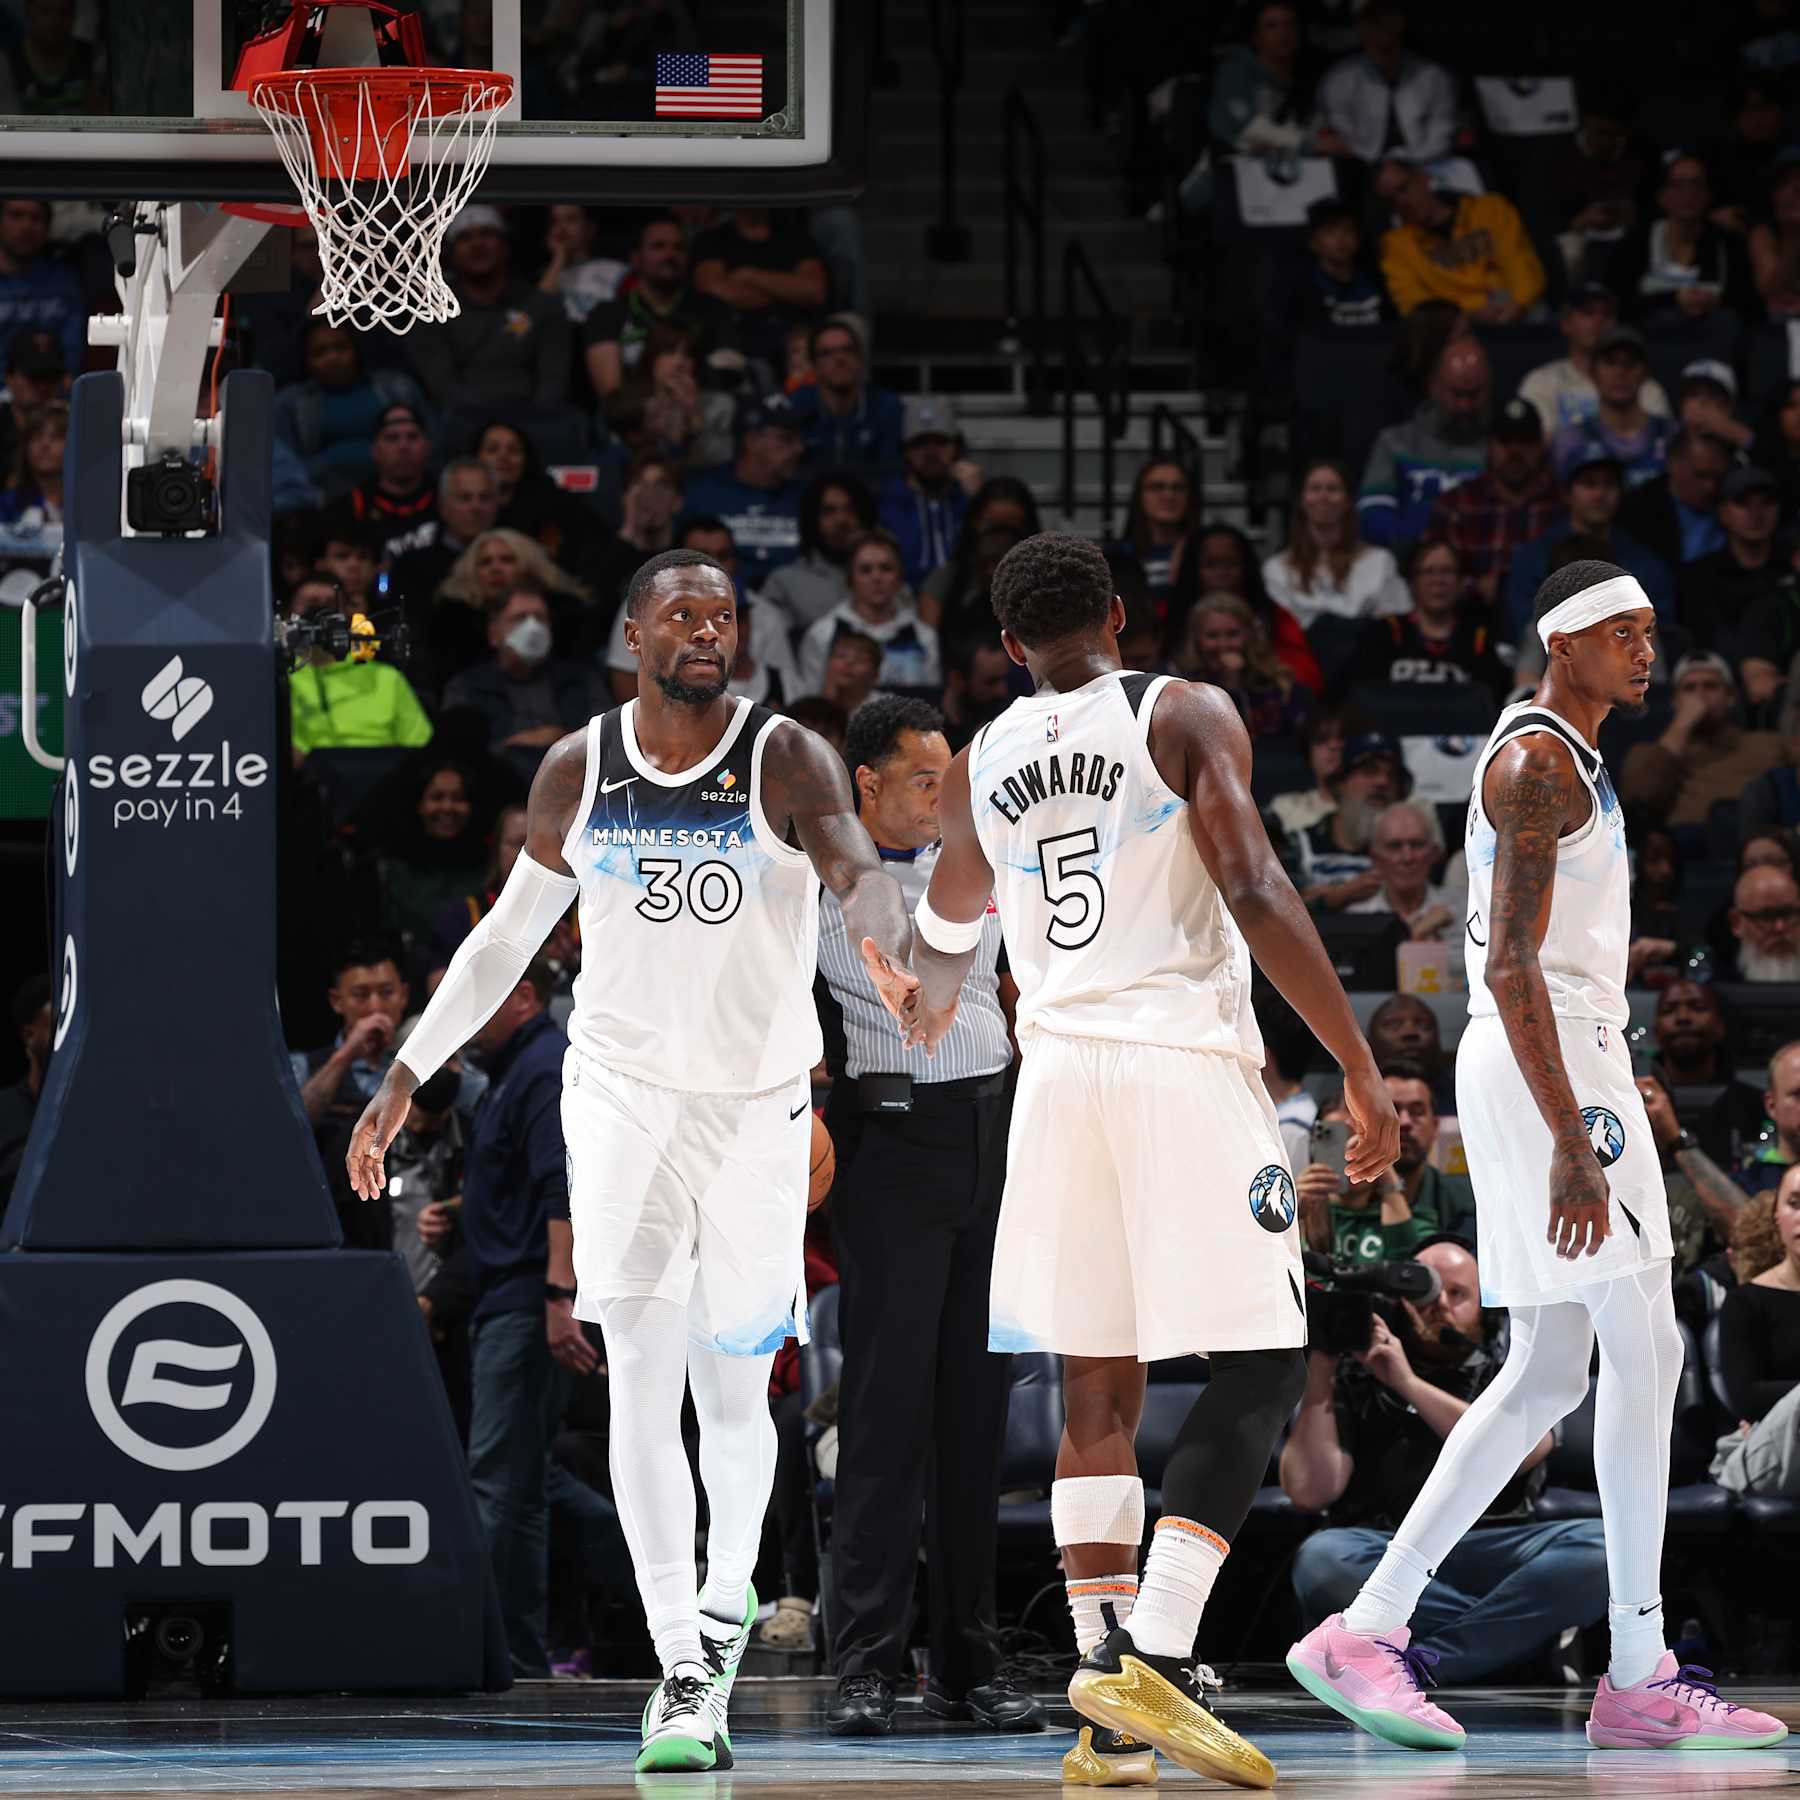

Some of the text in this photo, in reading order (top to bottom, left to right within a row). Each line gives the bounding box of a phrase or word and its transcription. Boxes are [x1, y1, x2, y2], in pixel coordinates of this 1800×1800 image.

[88, 740, 268, 789] sezzle
[989, 753, 1124, 825] EDWARDS
[114, 791, 243, 828] pay in 4
[701, 790, 748, 803] sezzle
[593, 828, 744, 849] MINNESOTA
[635, 858, 743, 925] 30
[1037, 826, 1105, 950] 5
[0, 1500, 429, 1568] FMOTO
